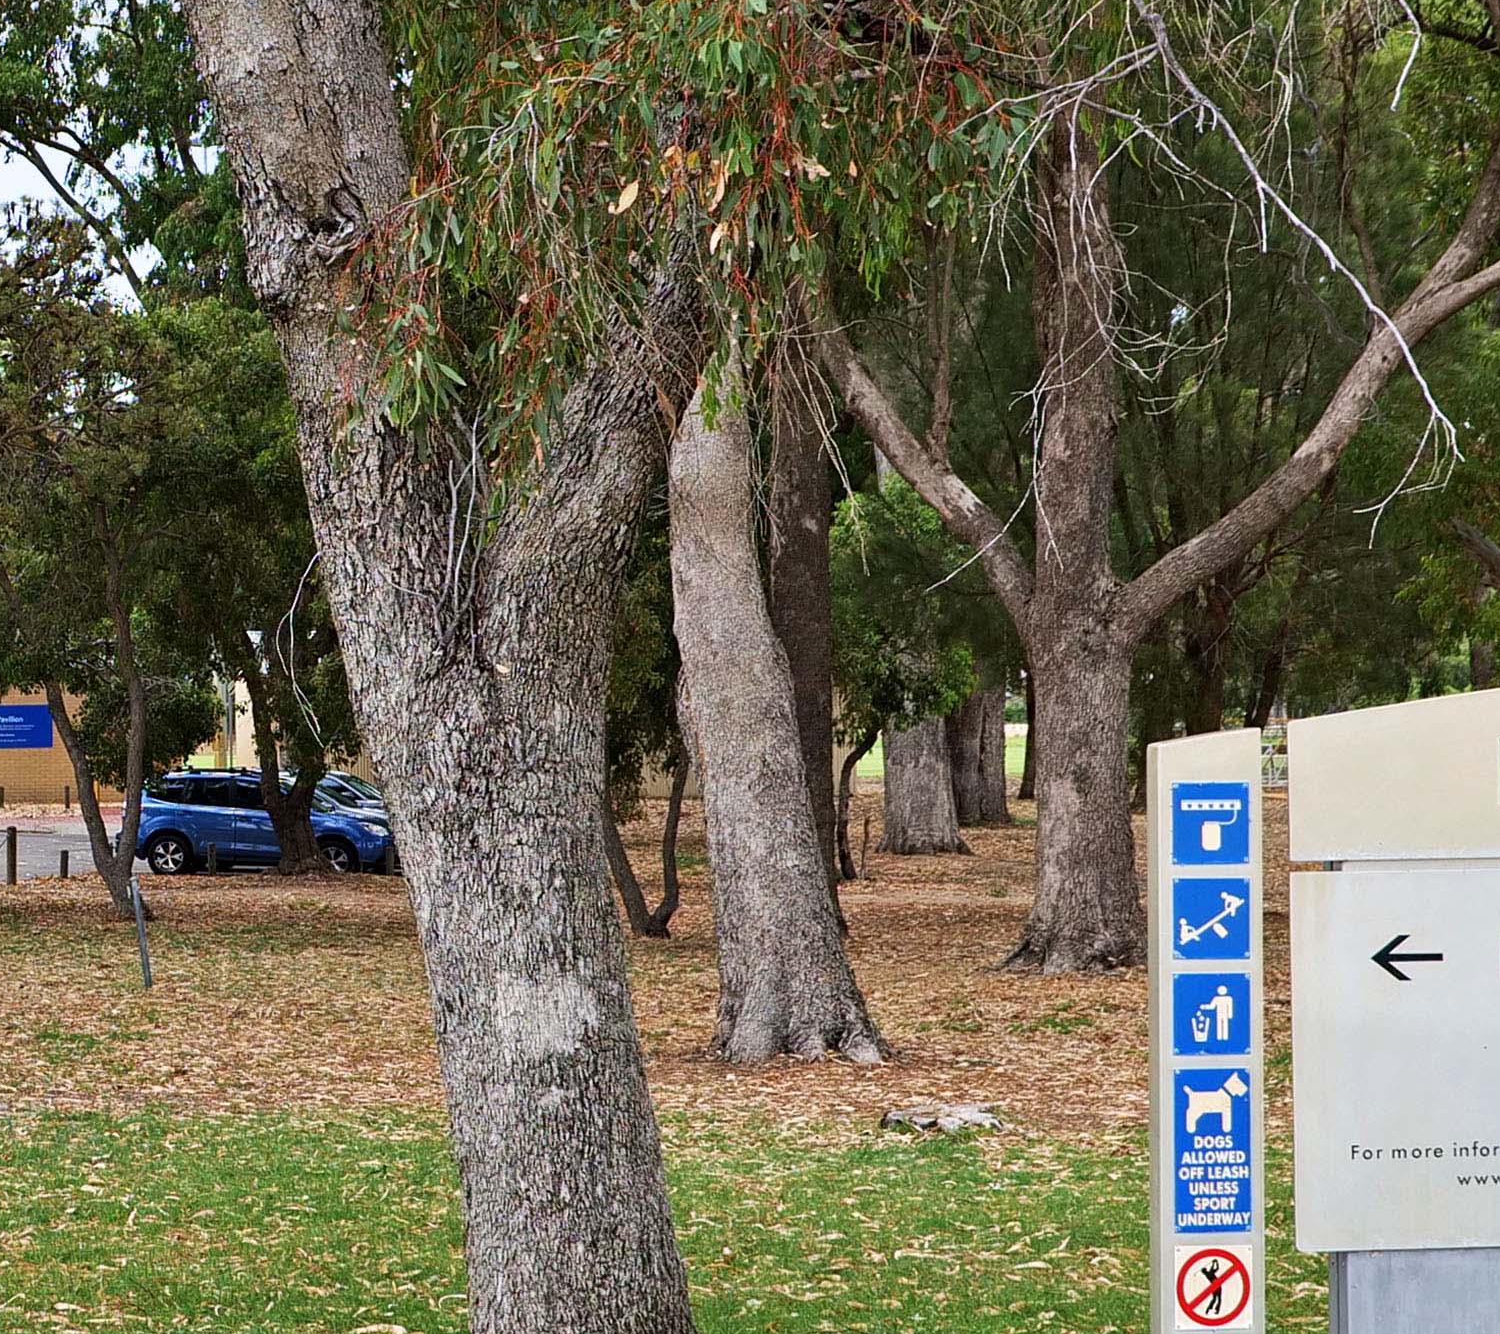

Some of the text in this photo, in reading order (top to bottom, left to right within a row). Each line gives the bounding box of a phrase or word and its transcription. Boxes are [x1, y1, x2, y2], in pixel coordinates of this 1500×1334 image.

[1194, 1136, 1233, 1148] DOGS
[1182, 1151, 1245, 1164] ALLOWED
[1352, 1145, 1382, 1160] For
[1392, 1148, 1443, 1158] more
[1179, 1166, 1249, 1180] OFF LEASH
[1189, 1181, 1239, 1195] UNLESS
[1194, 1197, 1235, 1210] SPORT
[1178, 1212, 1251, 1227] UNDERWAY
